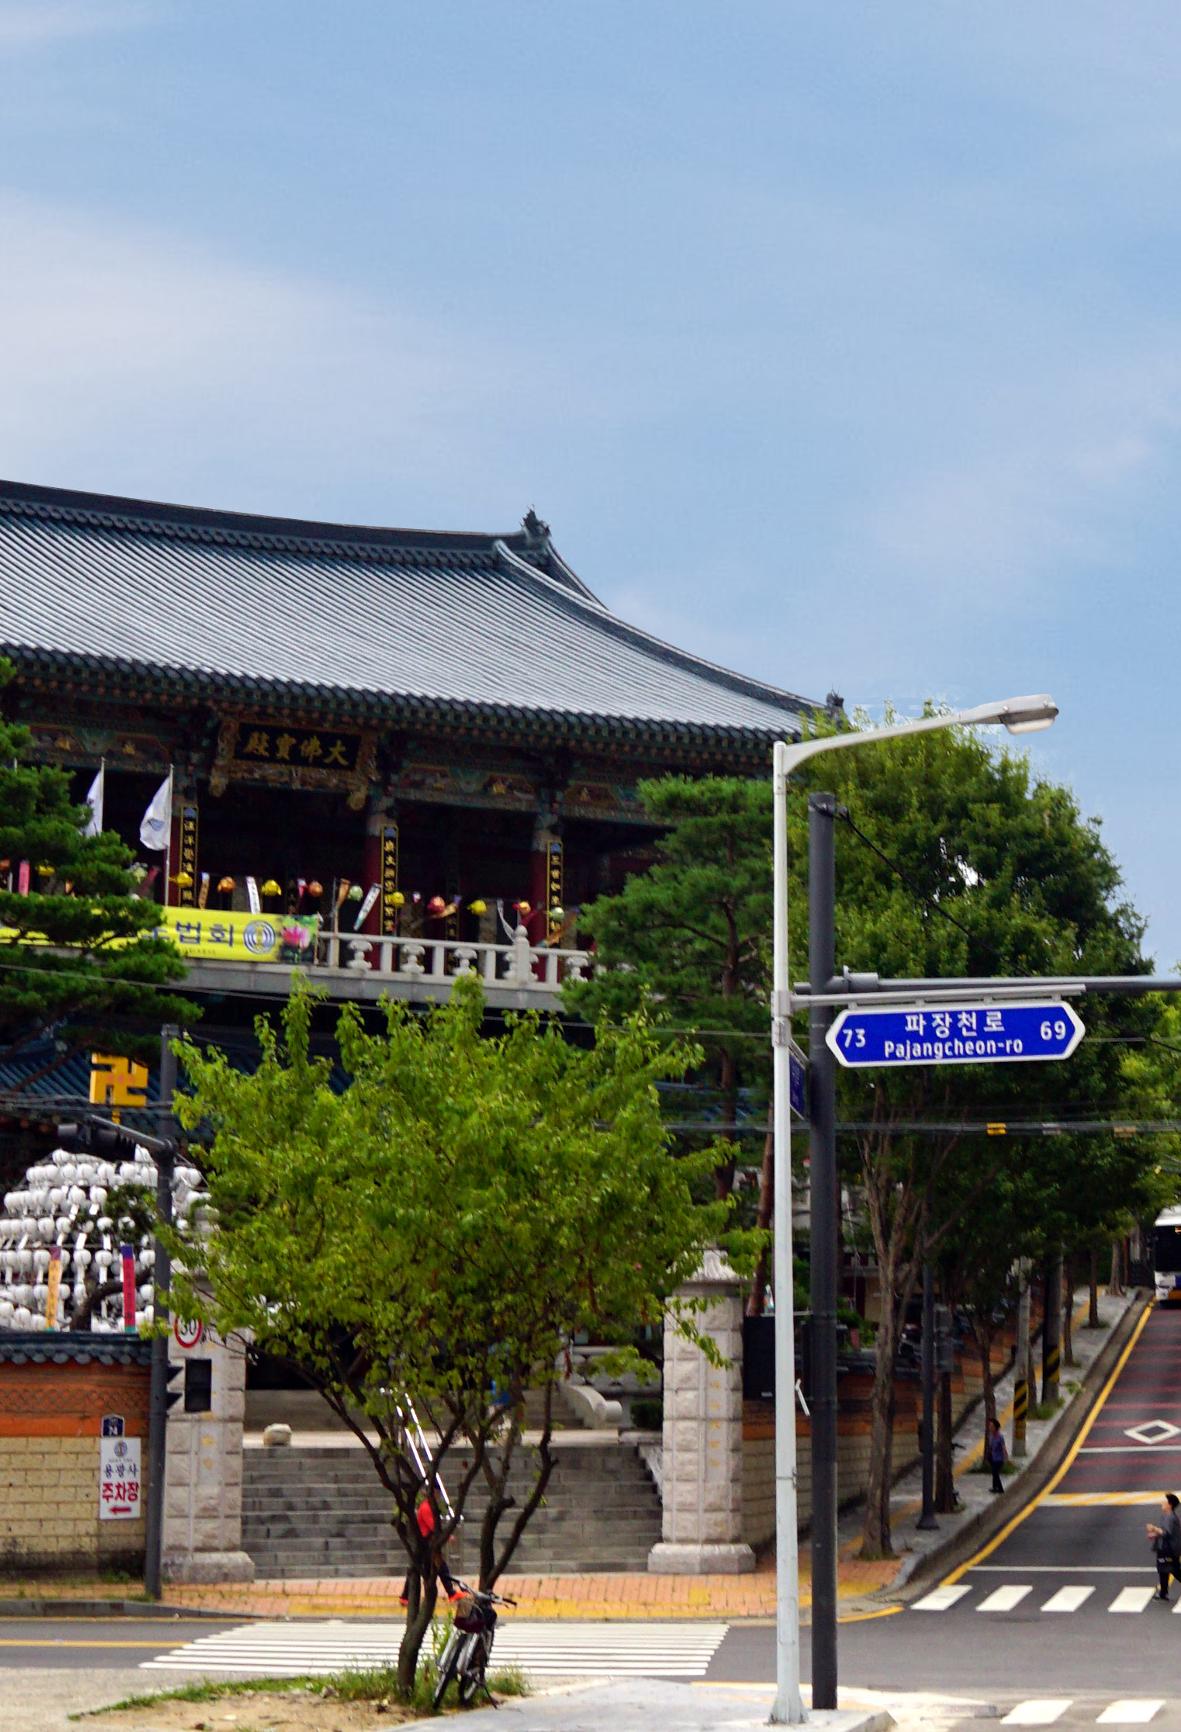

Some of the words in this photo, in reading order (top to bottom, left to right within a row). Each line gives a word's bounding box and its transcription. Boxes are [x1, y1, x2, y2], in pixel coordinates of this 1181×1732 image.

[905, 1010, 1006, 1038] 파장천로
[1039, 1021, 1067, 1041] 69
[842, 1028, 866, 1048] 73
[884, 1038, 1023, 1060] Pajangcheon-ro
[102, 1481, 139, 1503] 주차장
